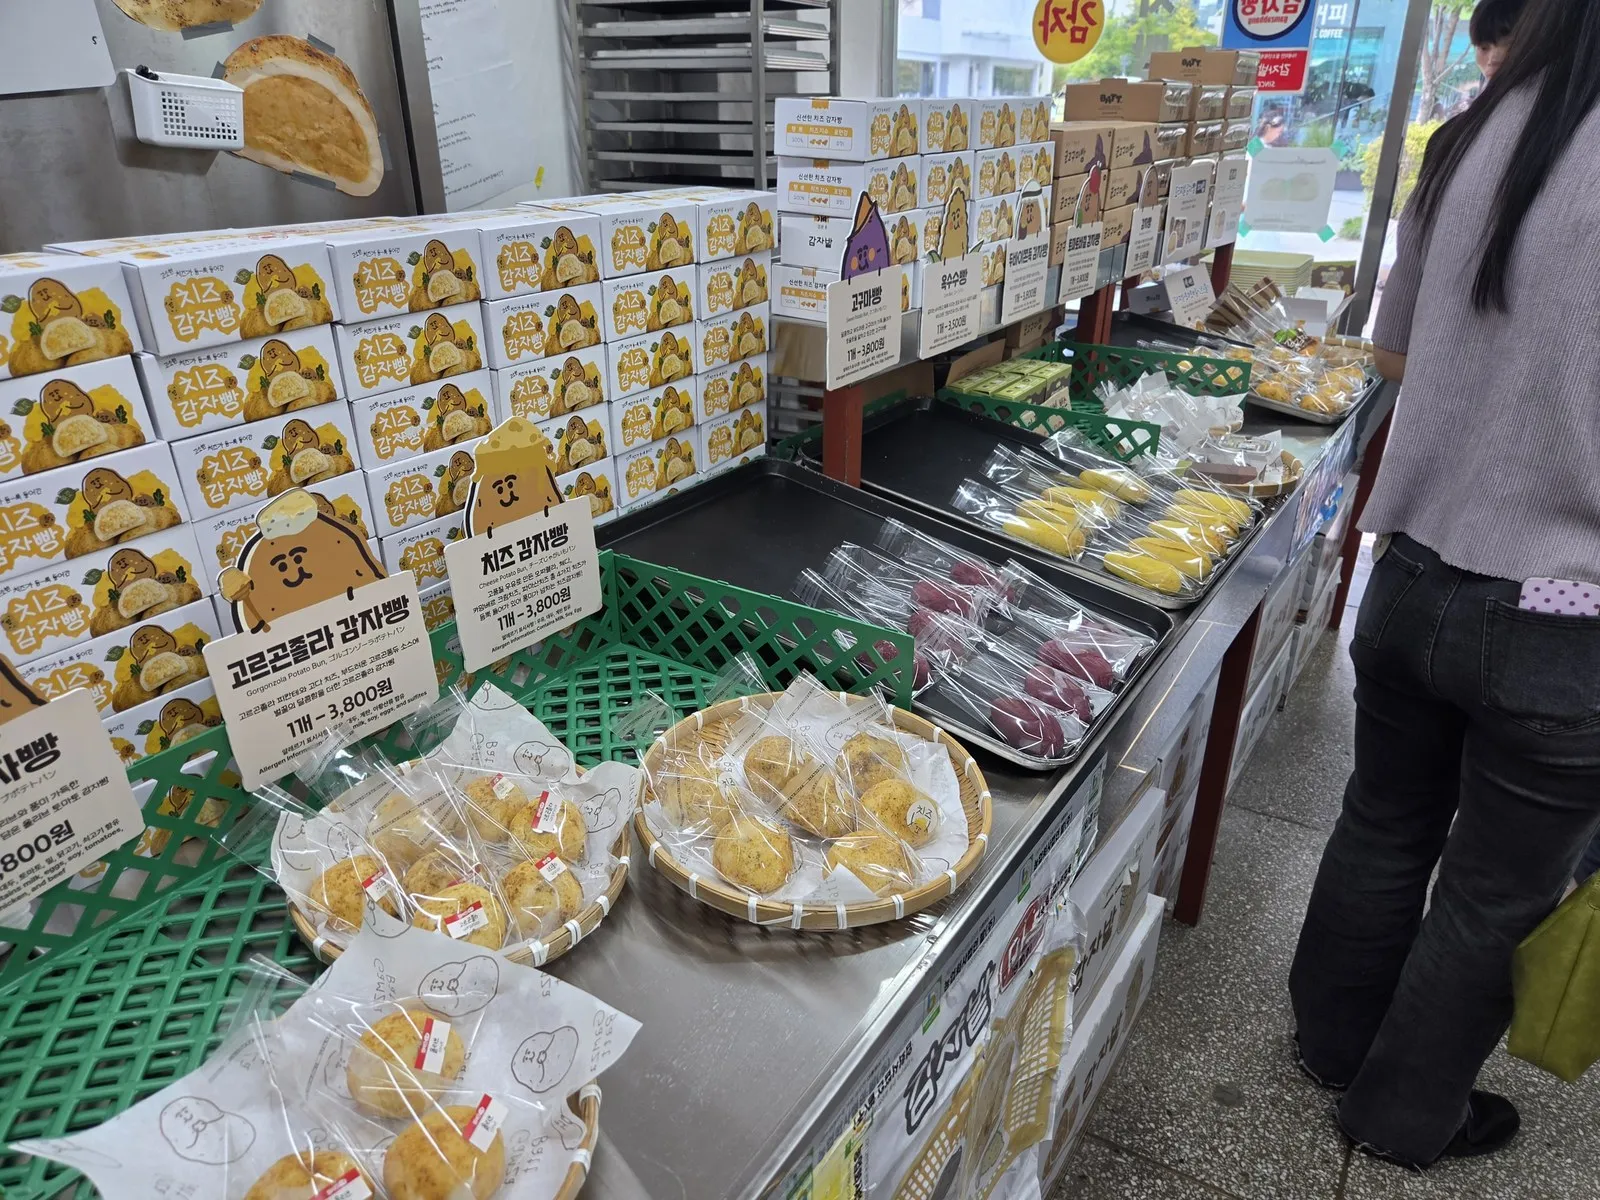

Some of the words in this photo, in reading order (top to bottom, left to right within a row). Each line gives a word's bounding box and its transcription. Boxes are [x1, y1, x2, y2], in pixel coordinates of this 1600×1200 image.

[1319, 29, 1343, 39] COFFEE
[815, 174, 825, 182] 치즈
[617, 229, 640, 247] 치즈
[504, 245, 532, 266] 치즈
[615, 248, 646, 267] 감자빵
[362, 261, 397, 284] 치즈
[502, 264, 539, 287] 감자빵
[804, 280, 813, 288] 치즈
[941, 269, 968, 290] 옥수수빵
[176, 283, 222, 308] 치즈
[359, 282, 407, 309] 감자빵
[619, 294, 640, 311] 치즈
[852, 286, 882, 312] 고구마빵
[174, 305, 236, 336] 감자빵
[510, 315, 536, 335] 치즈
[616, 311, 647, 331] 감자빵
[363, 337, 397, 360] 치즈
[506, 332, 543, 356] 감자빵
[862, 338, 885, 358] 3,800원
[360, 357, 408, 384] 감자빵
[622, 351, 643, 369] 치즈
[178, 368, 225, 394] 치즈
[620, 367, 649, 386] 감자빵
[516, 379, 543, 399] 치즈
[177, 390, 239, 422] 감자빵
[514, 396, 549, 417] 감자빵
[626, 407, 646, 424] 치즈
[379, 409, 412, 433] 치즈
[624, 422, 652, 442] 감자빵
[376, 426, 424, 454] 감자빵
[208, 450, 249, 478] 치즈
[630, 459, 650, 477] 치즈
[206, 470, 264, 503] 감자빵
[393, 476, 424, 500] 치즈
[628, 475, 656, 495] 감자빵
[390, 494, 433, 522] 감자빵
[407, 541, 438, 564] 치즈
[481, 545, 515, 575] 치즈
[517, 523, 569, 562] 감자빵
[478, 577, 498, 589] Cheese
[499, 569, 515, 580] Potato
[517, 564, 527, 573] Bun,
[14, 589, 66, 622] 치즈
[497, 611, 515, 630] 1개
[526, 586, 571, 618] 3,800원
[13, 608, 84, 650] 감자빵
[227, 625, 334, 689] 고르곤졸라
[336, 595, 410, 645] 감자빵
[39, 668, 90, 697] 치즈
[238, 699, 275, 720] 고르곤졸라
[308, 679, 323, 690] 고다
[324, 672, 339, 683] 치즈,
[341, 660, 367, 675] 부드러운
[400, 637, 419, 650] 소스에
[246, 674, 287, 697] Gorgonzola
[287, 665, 311, 679] Potato
[311, 658, 327, 670] Bun,
[273, 702, 296, 717] 벌꿀의
[297, 689, 324, 706] 달콤함을
[325, 682, 340, 693] 더한
[342, 668, 373, 686] 고르곤졸라
[375, 658, 394, 671] 감자빵
[287, 713, 313, 738] 1개
[328, 677, 393, 719] 3,800원
[258, 757, 286, 774] Allergen
[352, 718, 366, 730] milk,
[367, 713, 378, 723] soy,
[379, 705, 394, 717] eggs,
[395, 700, 406, 708] and
[407, 690, 427, 703] sulfites
[22, 809, 51, 829] 올리브
[52, 793, 81, 812] 토마토
[82, 776, 109, 796] 감자빵
[30, 795, 49, 813] 풍미
[50, 779, 80, 801] 가득한
[916, 805, 933, 820] 치즈
[22, 875, 44, 888] milk,
[44, 861, 67, 877] eggs,
[68, 849, 84, 862] soy,
[85, 828, 124, 851] tomatoes,
[31, 880, 47, 893] and
[48, 868, 66, 882] beef
